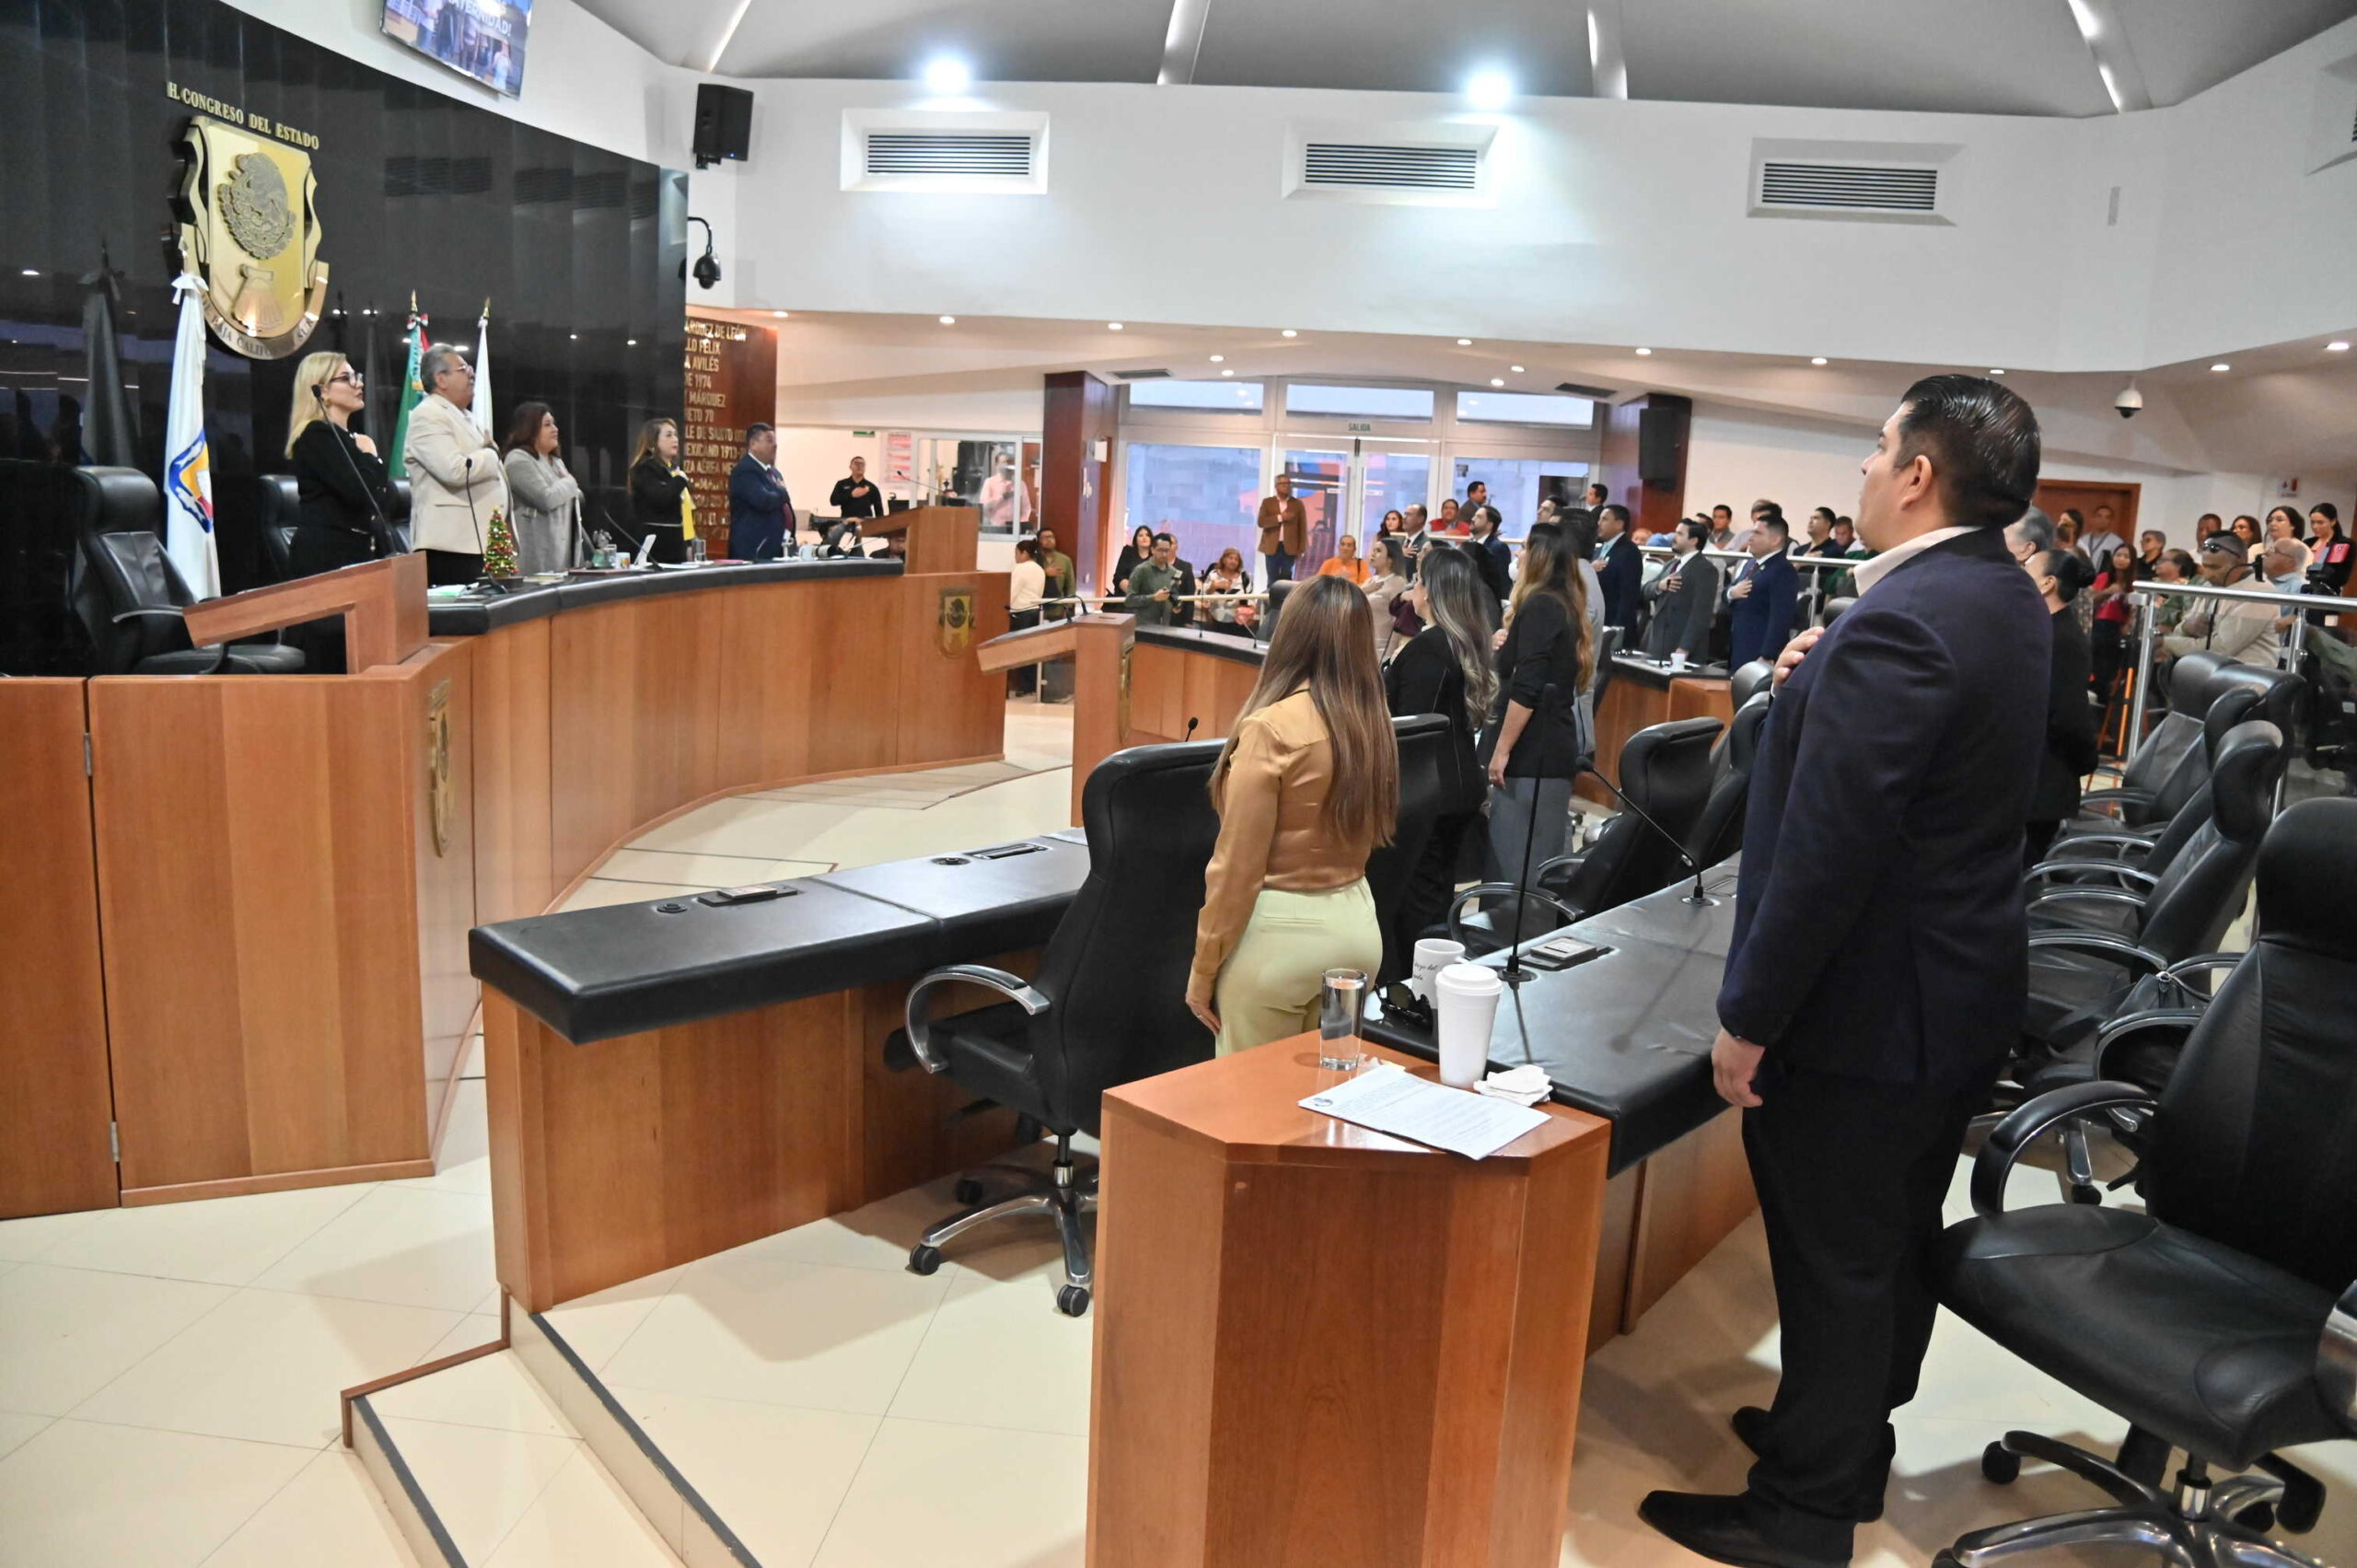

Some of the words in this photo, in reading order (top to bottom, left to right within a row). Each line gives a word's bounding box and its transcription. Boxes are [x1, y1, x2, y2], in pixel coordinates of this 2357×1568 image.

[181, 87, 245, 125] CONGRESO
[248, 112, 272, 134] DEL
[275, 122, 320, 150] ESTADO
[714, 324, 725, 339] DE
[691, 355, 719, 372] AVILÉS
[694, 374, 712, 390] 1974
[689, 389, 726, 408] MÁRQUEZ
